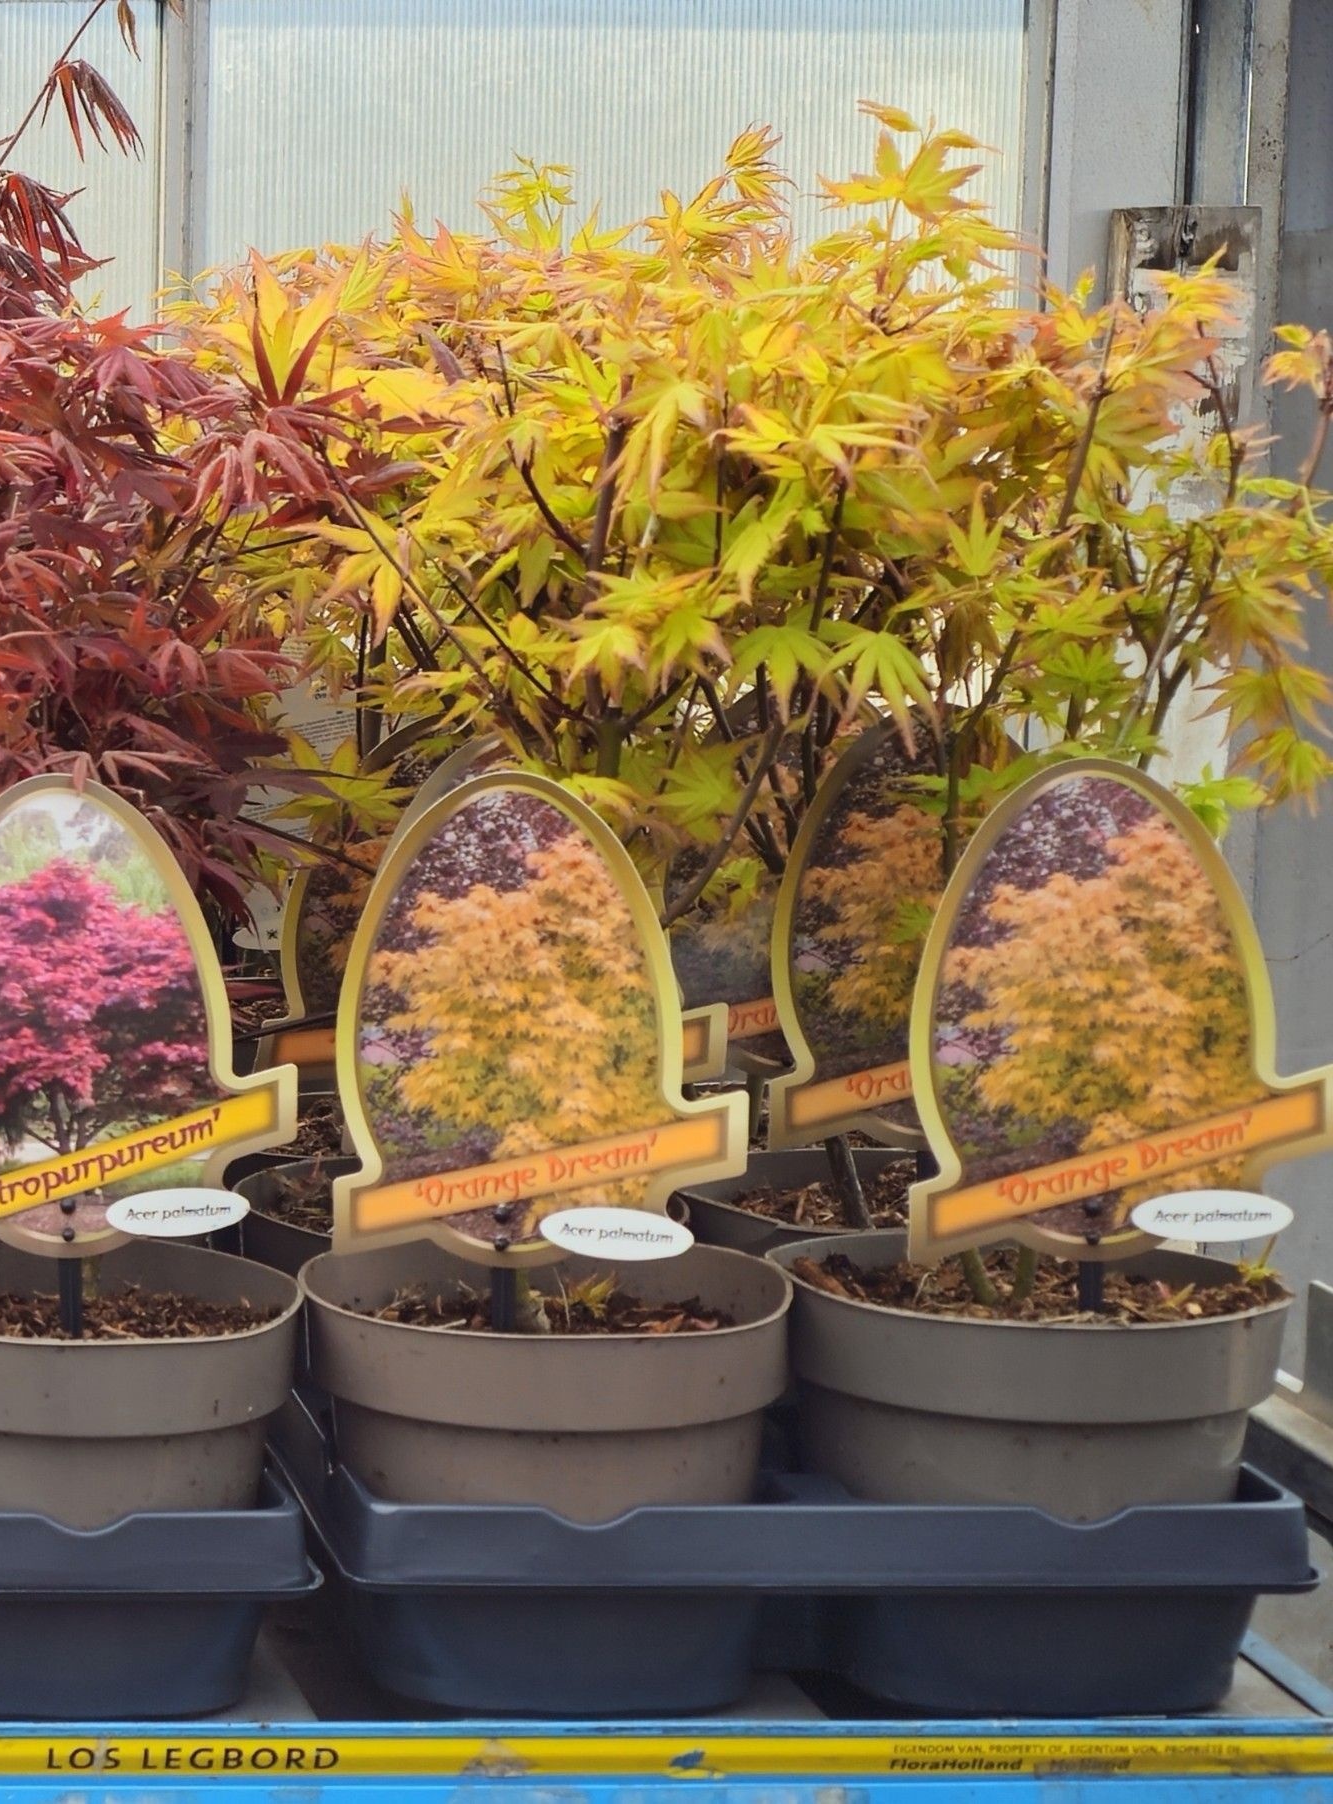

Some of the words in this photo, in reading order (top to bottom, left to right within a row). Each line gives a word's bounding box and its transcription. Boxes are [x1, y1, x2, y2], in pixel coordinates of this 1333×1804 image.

[997, 1156, 1129, 1207] 'Orange
[1135, 1110, 1253, 1170] Dream'
[414, 1165, 538, 1207] 'Orange
[545, 1132, 658, 1184] Dream'
[125, 1208, 157, 1221] Acer
[162, 1204, 231, 1220] palmatum
[1154, 1210, 1189, 1222] Acer
[1194, 1210, 1272, 1225] palmatum
[559, 1223, 595, 1236] Acer
[598, 1226, 674, 1244] palmatum
[46, 1747, 122, 1770] LOS
[141, 1747, 340, 1770] LEGBORD
[889, 1758, 1023, 1771] FloraHolland
